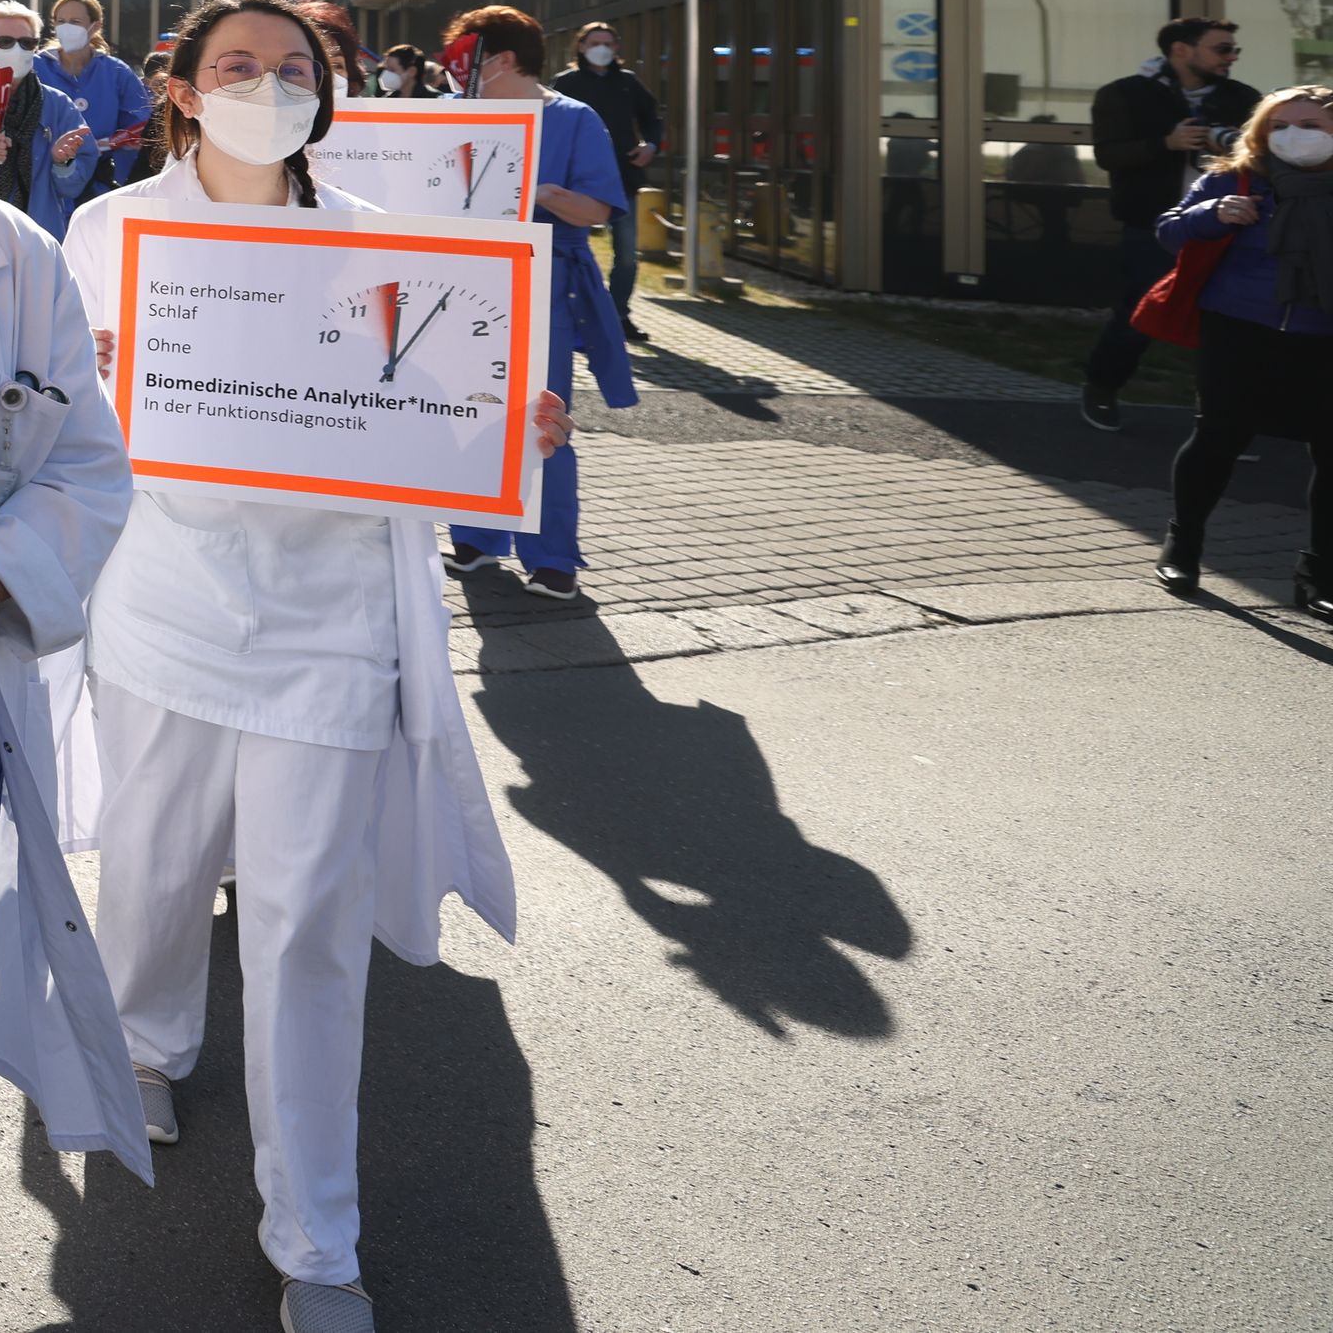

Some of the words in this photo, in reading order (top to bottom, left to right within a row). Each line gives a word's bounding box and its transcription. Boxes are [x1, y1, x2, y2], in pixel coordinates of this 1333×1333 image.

[346, 149, 378, 161] klare
[382, 149, 413, 161] Sicht
[507, 162, 515, 173] 2
[427, 177, 441, 188] 10
[149, 280, 185, 298] Kein
[189, 284, 285, 305] erholsamer
[148, 302, 198, 321] Schlaf
[350, 304, 367, 319] 11
[318, 329, 341, 345] 10
[471, 320, 490, 337] 2
[146, 337, 192, 355] Ohne
[491, 361, 506, 380] 3
[145, 373, 298, 401] Biomedizinische
[144, 397, 159, 412] In
[163, 399, 192, 415] der
[197, 402, 368, 431] Funktionsdiagnostik
